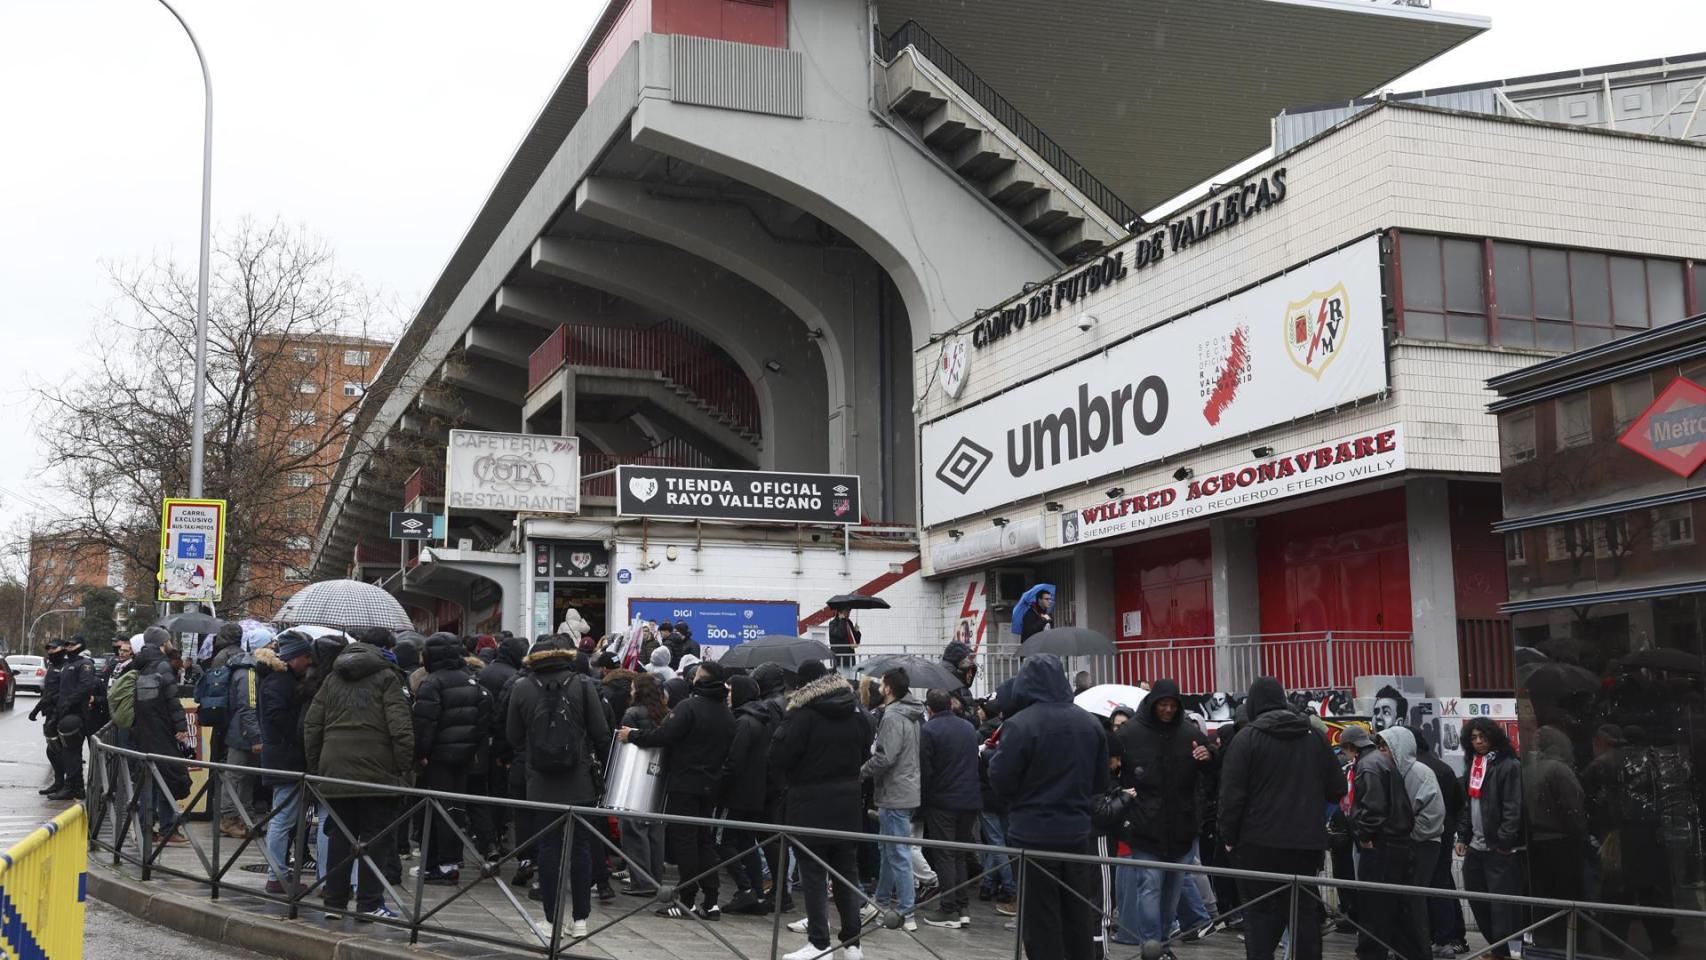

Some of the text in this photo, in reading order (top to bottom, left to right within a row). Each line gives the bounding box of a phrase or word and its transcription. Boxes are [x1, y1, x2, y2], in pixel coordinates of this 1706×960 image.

[972, 303, 1026, 349] CAMPO
[1028, 288, 1052, 322] DE
[1134, 231, 1165, 269] DE
[1168, 167, 1287, 251] VALLECAS
[1007, 375, 1169, 478] umbro
[453, 434, 549, 452] CAFETERIA
[1081, 429, 1396, 525] WILFRED AGBONAVBARE
[666, 478, 822, 496] TIENDA OFICIAL
[451, 492, 576, 512] RESTAURANTE
[666, 492, 713, 506] RAYO
[719, 494, 822, 510] VALLECANO
[1083, 458, 1396, 539] SIEMPRE EN NUESTRO RECUERDO ETERNO WILLY
[673, 609, 692, 618] DIGI
[707, 628, 728, 639] 500
[743, 628, 757, 639] 50
